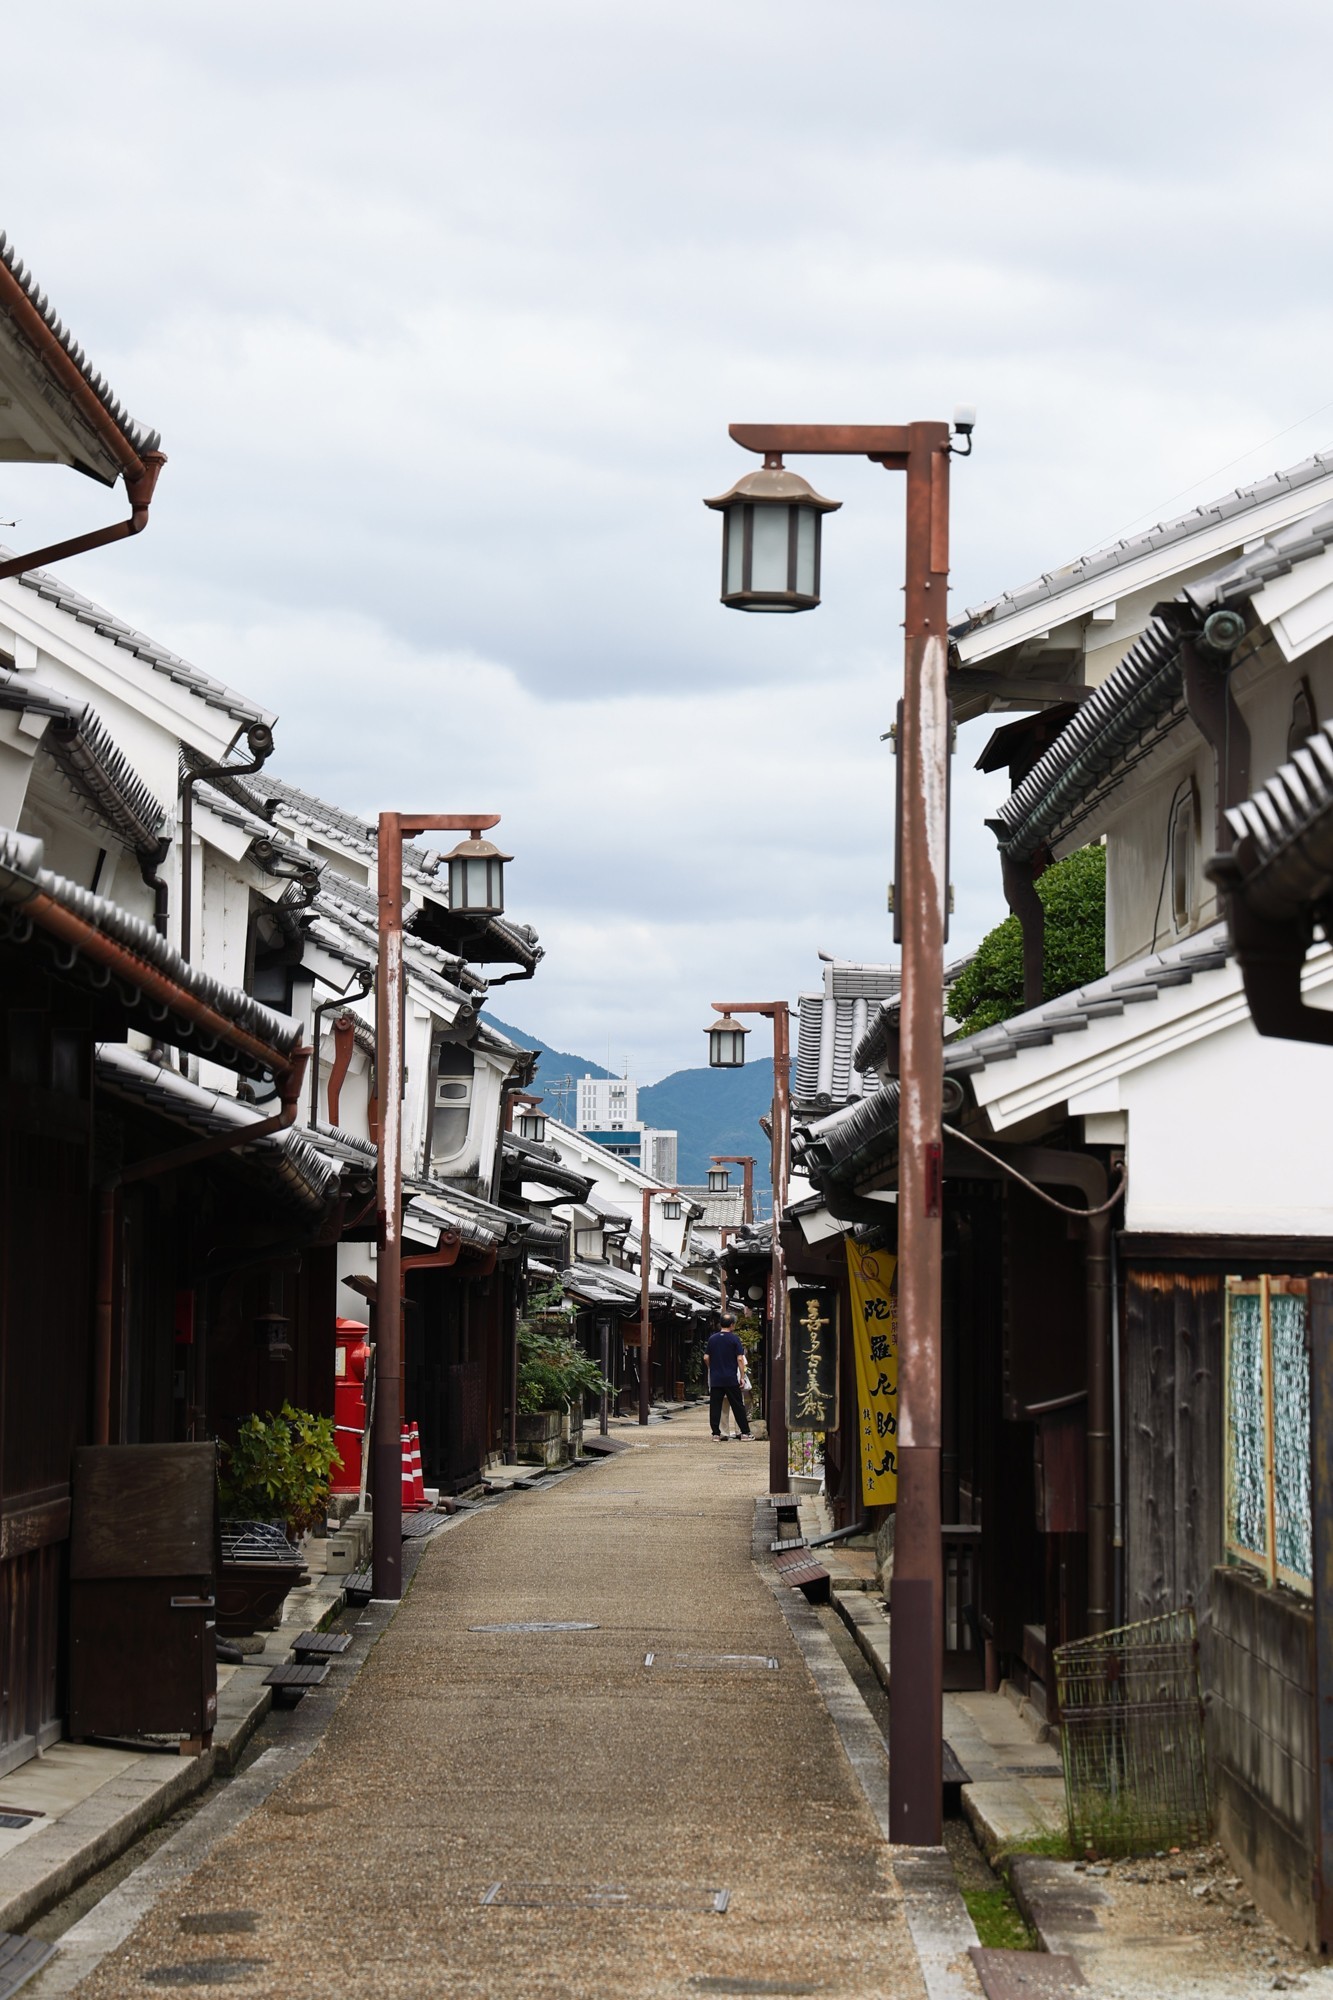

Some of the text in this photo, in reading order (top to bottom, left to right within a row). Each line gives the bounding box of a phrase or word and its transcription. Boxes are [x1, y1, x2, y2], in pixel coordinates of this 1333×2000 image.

[864, 1298, 898, 1477] 陀羅尼助丸
